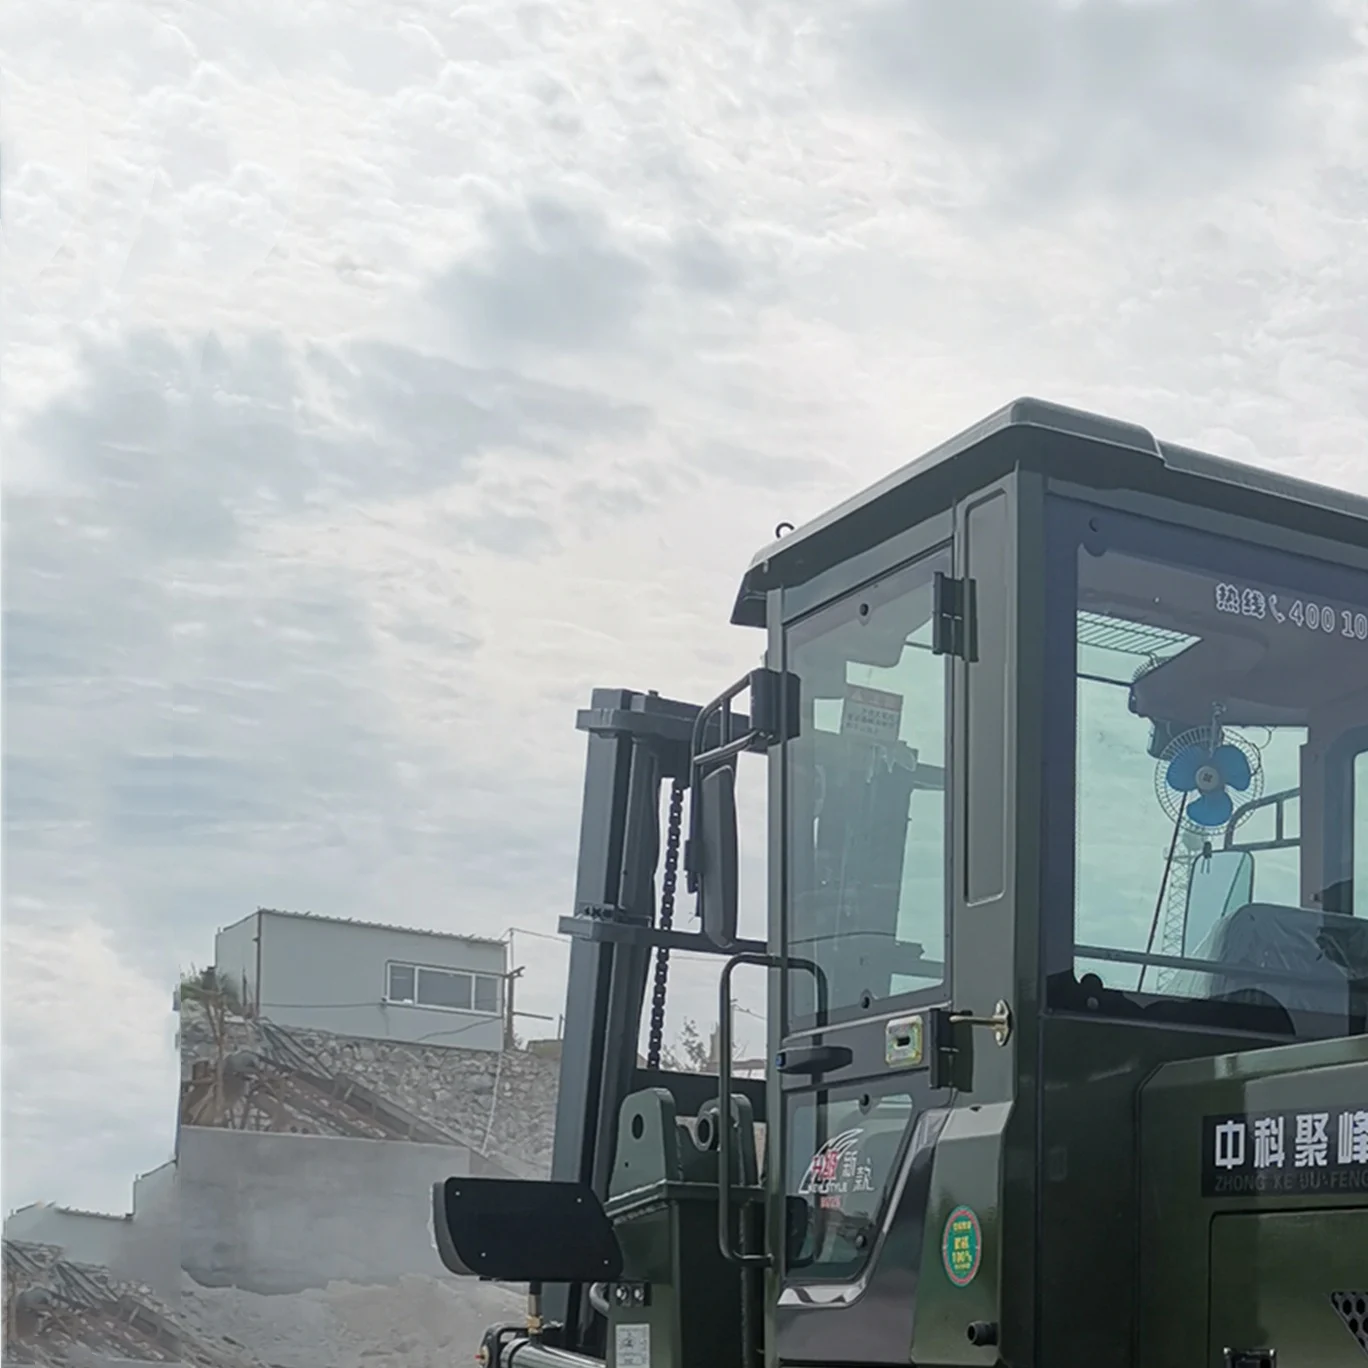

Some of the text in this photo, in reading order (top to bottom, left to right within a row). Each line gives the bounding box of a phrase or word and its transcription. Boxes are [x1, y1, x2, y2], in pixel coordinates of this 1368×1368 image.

[1215, 582, 1266, 619] 热线
[1288, 599, 1336, 633] 400
[1215, 1172, 1268, 1192] ZHONG
